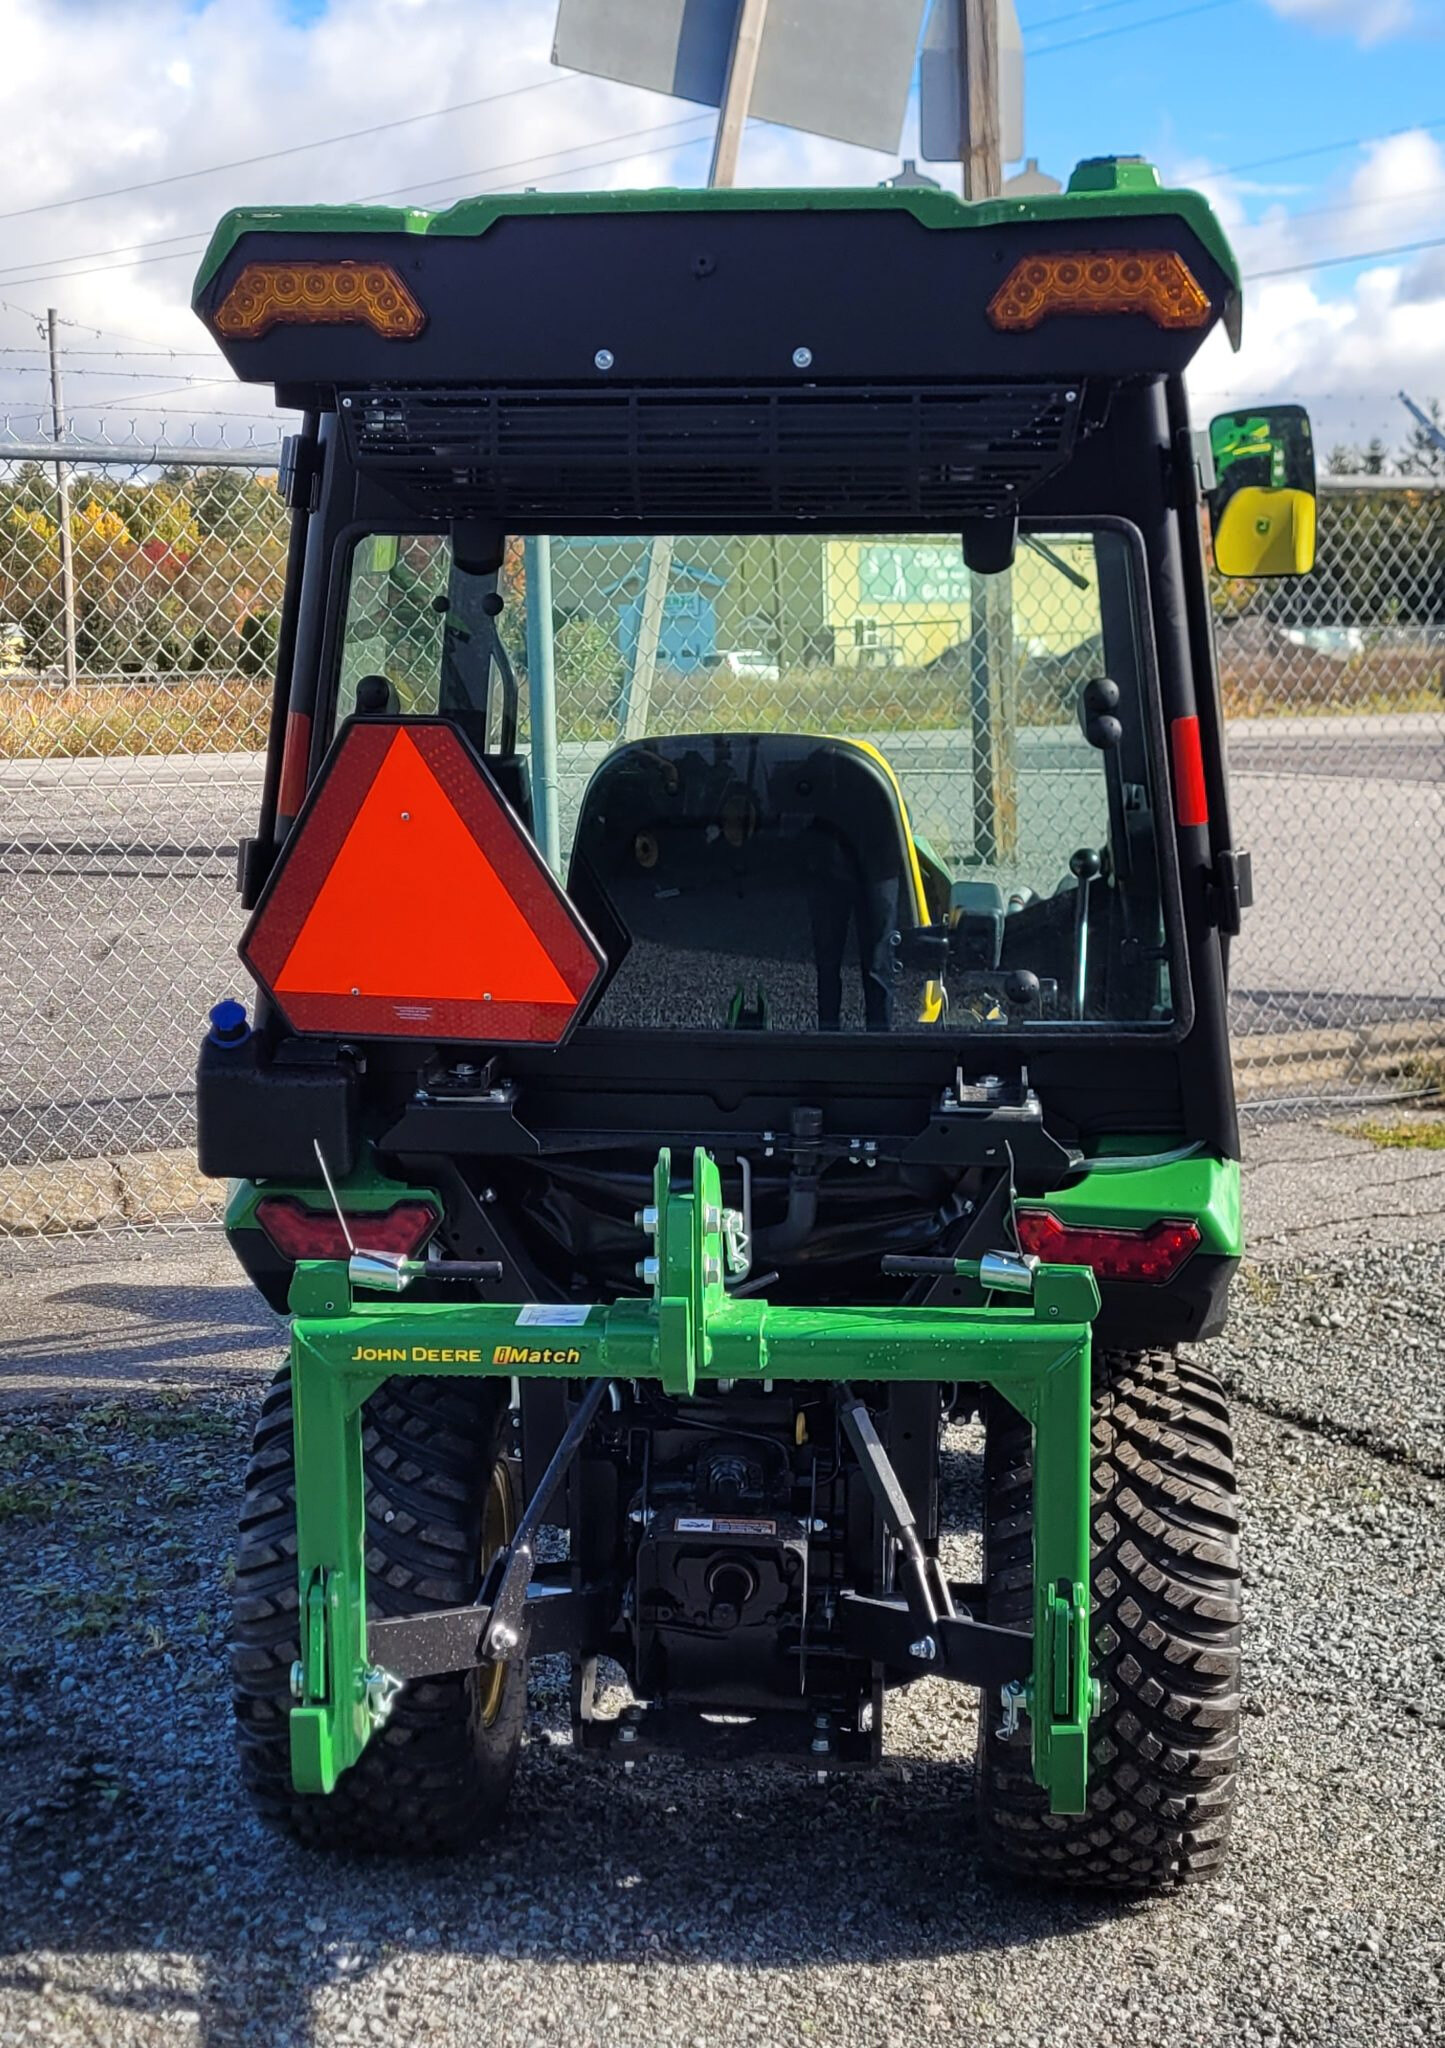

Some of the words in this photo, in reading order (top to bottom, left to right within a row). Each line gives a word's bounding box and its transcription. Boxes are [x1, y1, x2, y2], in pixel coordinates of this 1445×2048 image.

[352, 1345, 407, 1362] JOHN
[412, 1346, 482, 1362] DEERE
[491, 1345, 580, 1362] iMatch
